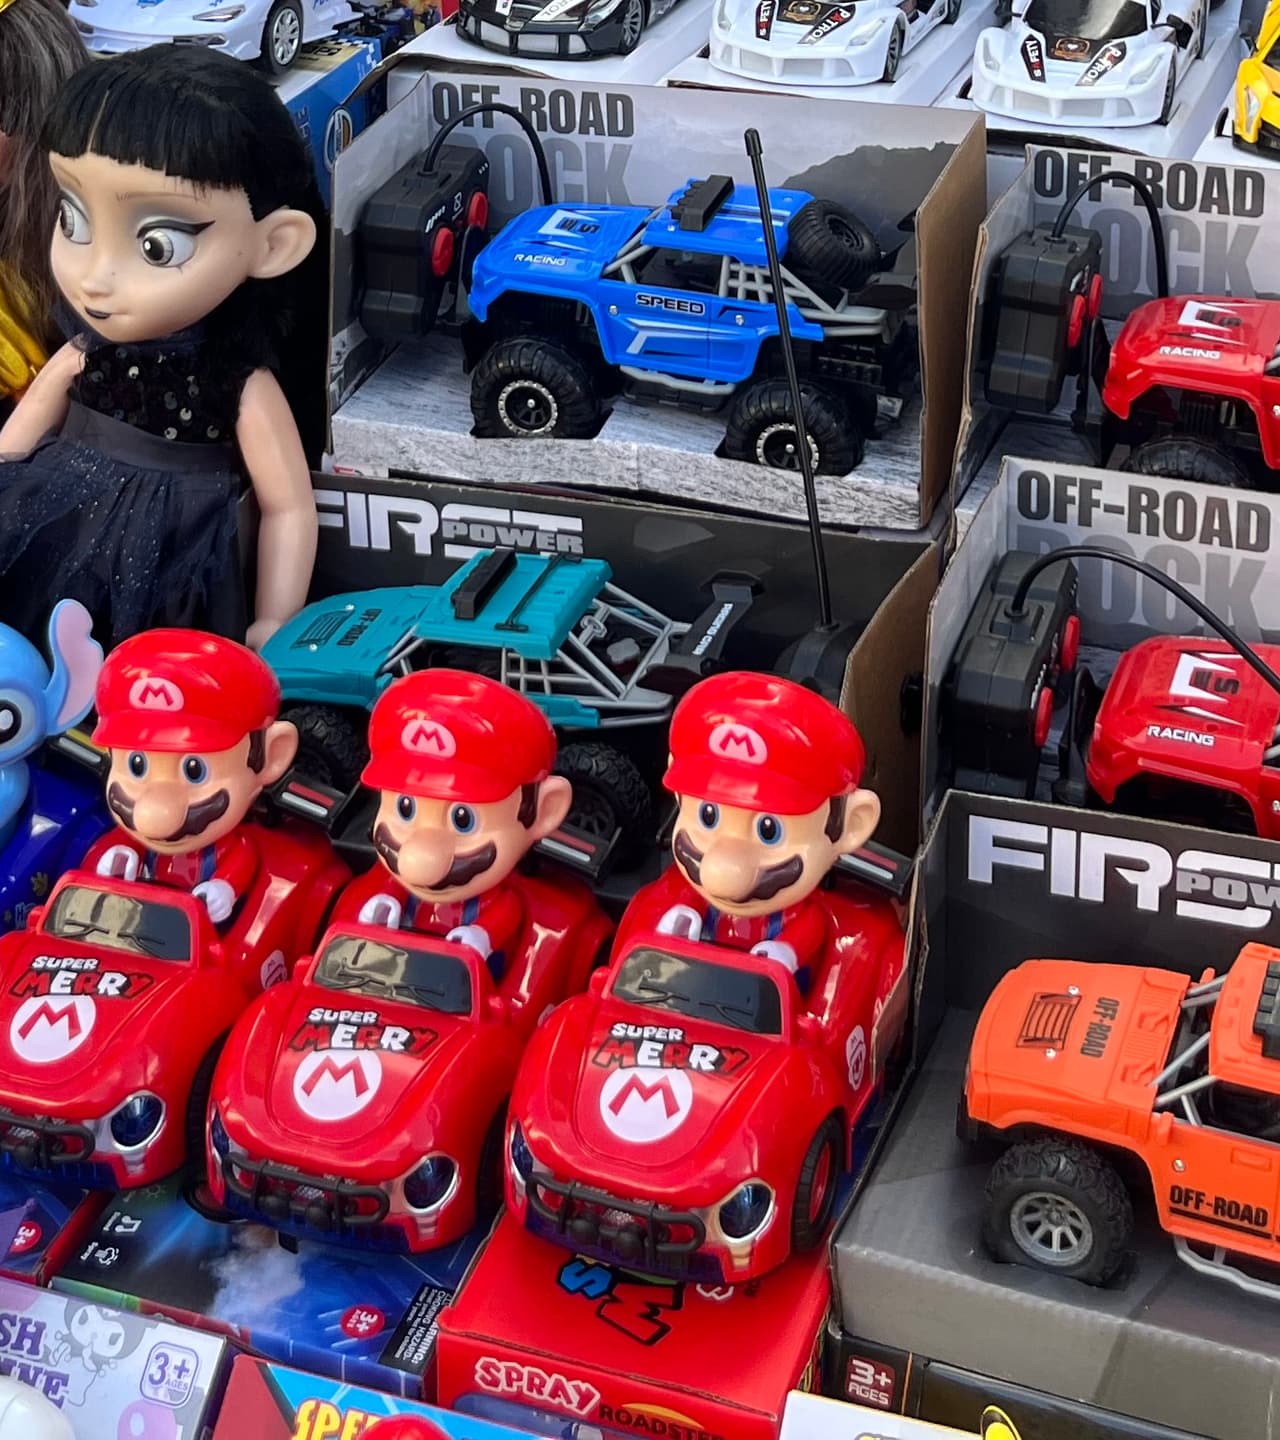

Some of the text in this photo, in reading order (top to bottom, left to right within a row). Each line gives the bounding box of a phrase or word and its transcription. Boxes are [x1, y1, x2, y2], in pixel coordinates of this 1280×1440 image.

[758, 0, 773, 37] SAFETY
[806, 8, 852, 46] PATROL
[1024, 39, 1043, 79] SAFETY
[1083, 44, 1123, 86] PATROL
[513, 253, 569, 267] RACING
[634, 292, 707, 316] SPEED
[1158, 345, 1222, 360] RACING
[1016, 469, 1272, 553] OFF-ROAD
[441, 518, 584, 555] POWER
[1146, 723, 1216, 748] RACING
[30, 954, 100, 971] SUPER
[8, 968, 158, 999] MERRY
[17, 1000, 84, 1041] M
[307, 1007, 379, 1025] SUPER
[608, 1023, 685, 1042] SUPER
[1081, 996, 1120, 1059] OFF-ROAD
[289, 1021, 440, 1053] MERRY
[592, 1039, 751, 1074] MERRY
[299, 1053, 370, 1099] M
[607, 1072, 681, 1120] M
[1168, 1184, 1270, 1229] OFF-ROAD
[411, 1321, 438, 1364] ARNING:
[148, 1351, 191, 1385] 3+
[164, 1377, 190, 1392] AGES
[849, 1358, 892, 1384] 3+
[473, 1356, 602, 1417] SPRAY
[847, 1380, 890, 1407] AGES
